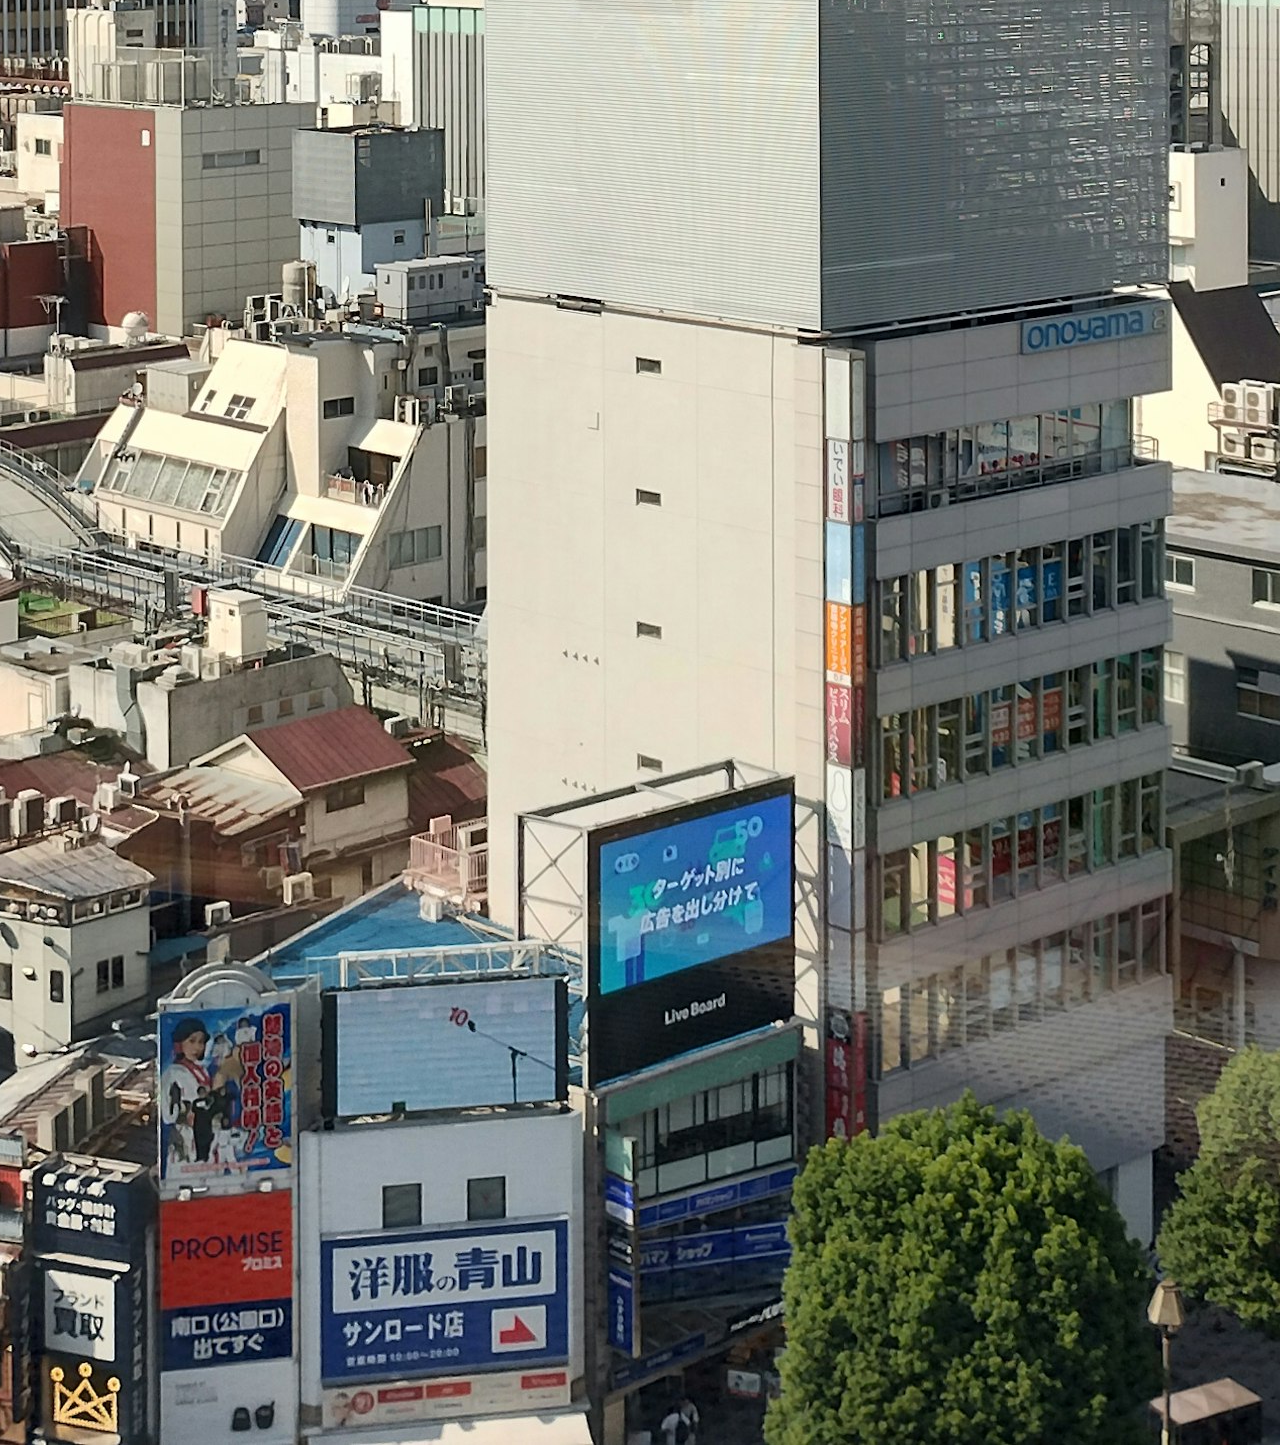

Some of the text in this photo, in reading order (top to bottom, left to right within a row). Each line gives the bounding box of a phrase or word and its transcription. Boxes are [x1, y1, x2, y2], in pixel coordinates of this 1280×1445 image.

[1027, 310, 1144, 349] onoyama
[839, 688, 851, 725] スリム
[735, 815, 764, 844] 50
[652, 858, 745, 900] ターゲット別に
[640, 882, 760, 933] 広告を出し分けて
[664, 993, 726, 1025] Live Board
[171, 1230, 285, 1262] PROMISE
[241, 1256, 283, 1272] プロミス
[348, 1245, 542, 1301] 洋服の青山
[53, 1306, 104, 1342] 買取
[171, 1306, 285, 1338] 南口(公園口)
[342, 1310, 465, 1347] サンロード店
[193, 1332, 265, 1361] 出てすぐ
